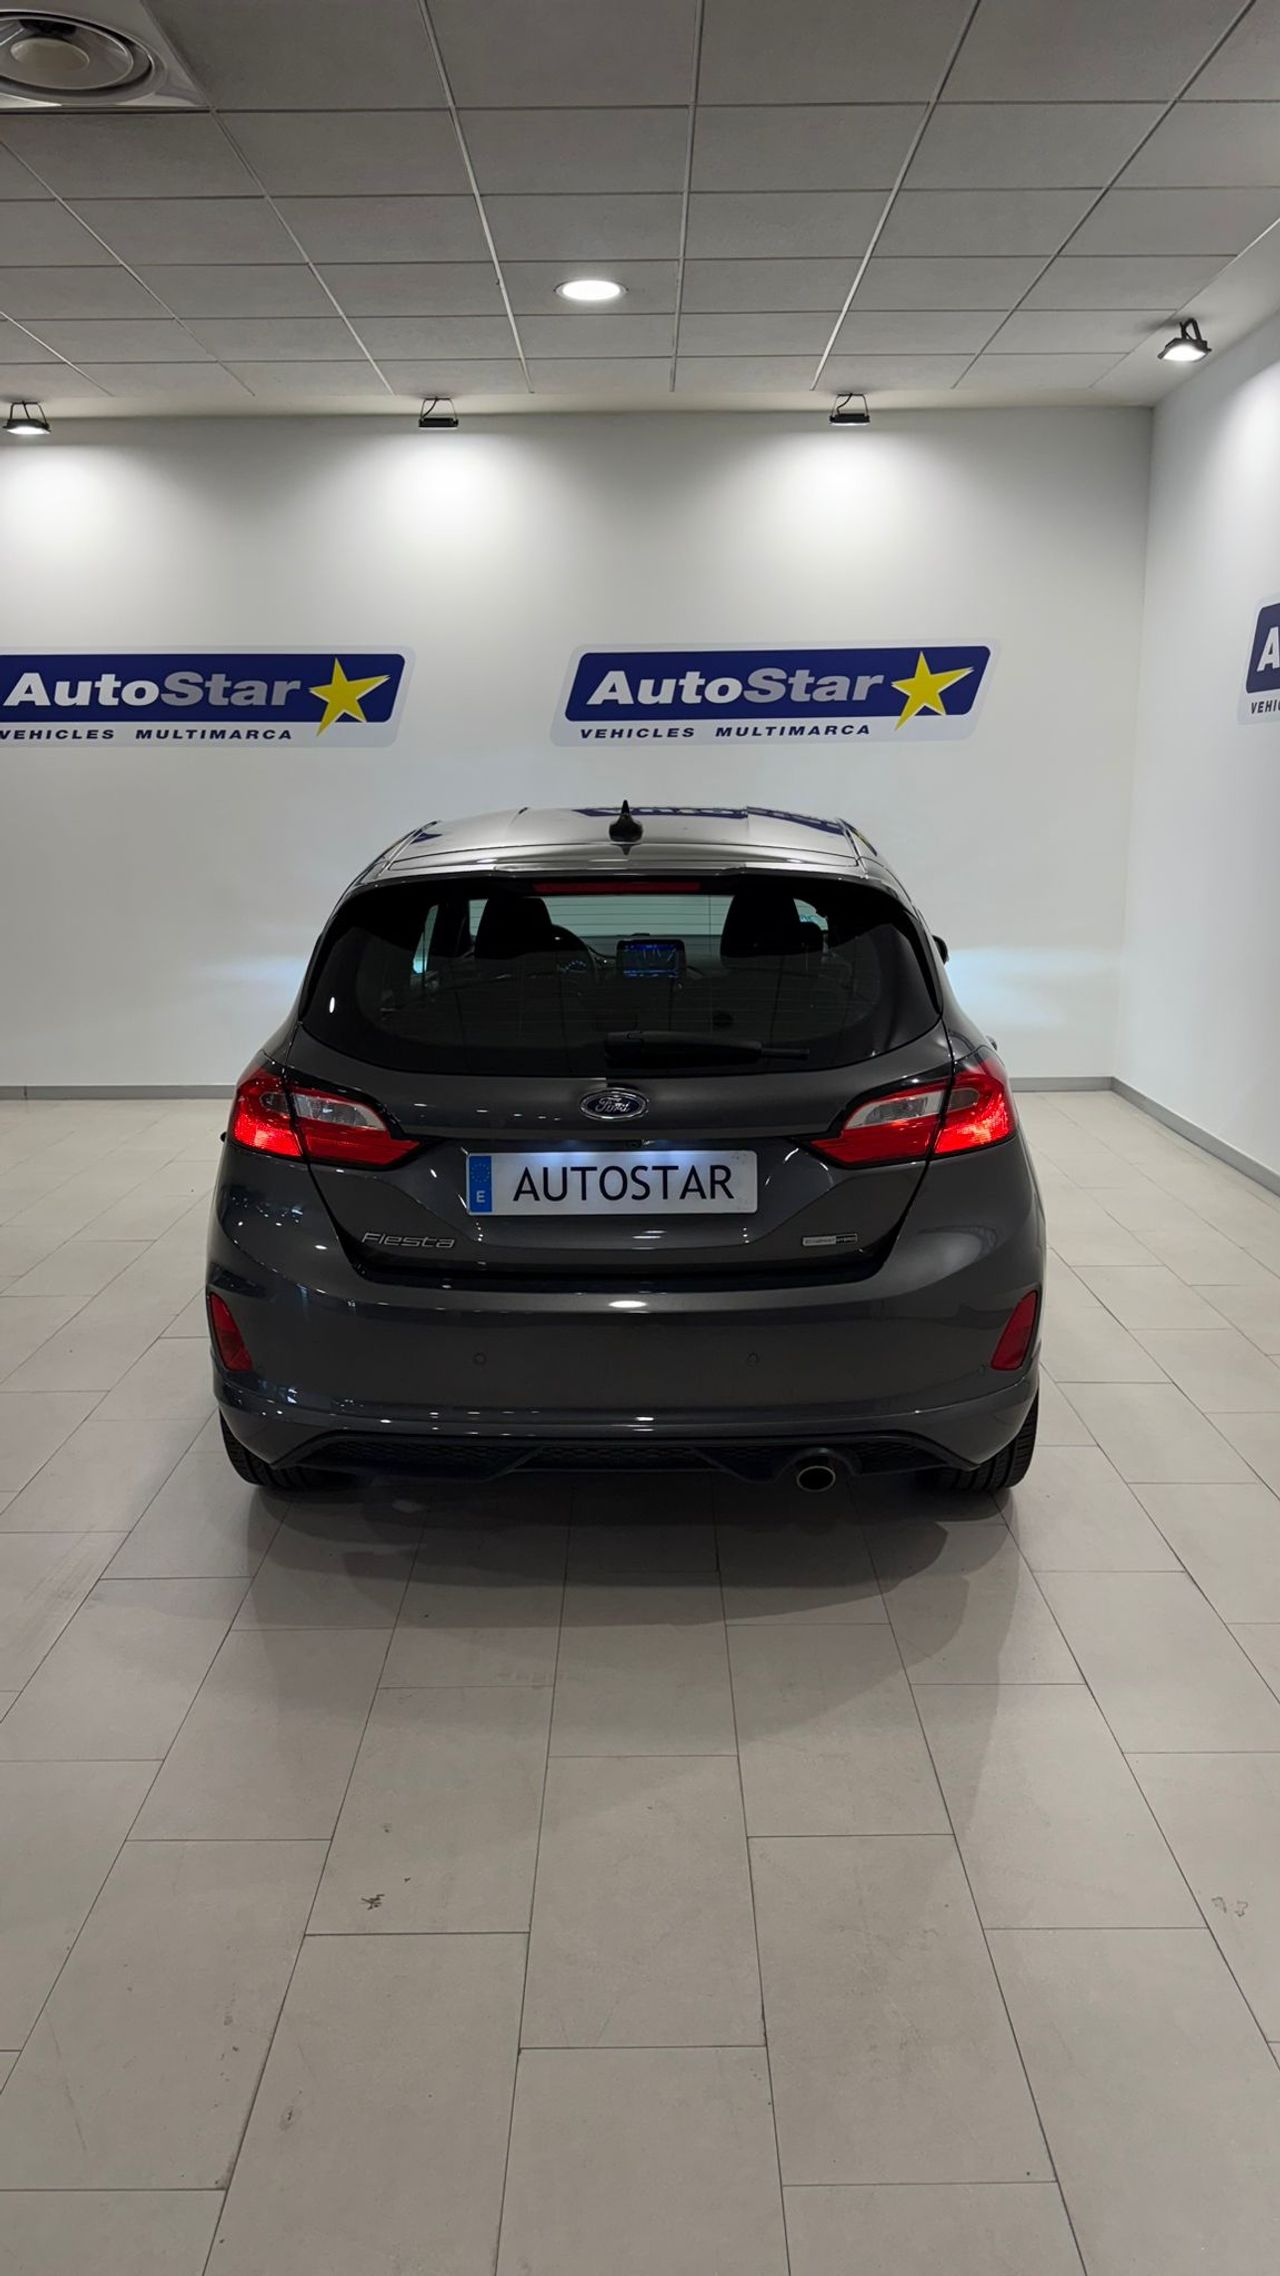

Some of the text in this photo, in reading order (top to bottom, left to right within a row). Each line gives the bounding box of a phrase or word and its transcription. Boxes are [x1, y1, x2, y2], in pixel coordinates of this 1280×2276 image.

[3, 671, 301, 706] AutoStar
[586, 667, 884, 706] AutoStar
[0, 729, 292, 740] VEHICLES MULTIMARCA
[580, 724, 870, 739] VEHICLES MULTIMARCA
[476, 1164, 734, 1203] E AUTOSTAR
[361, 1232, 456, 1249] Fiesta
